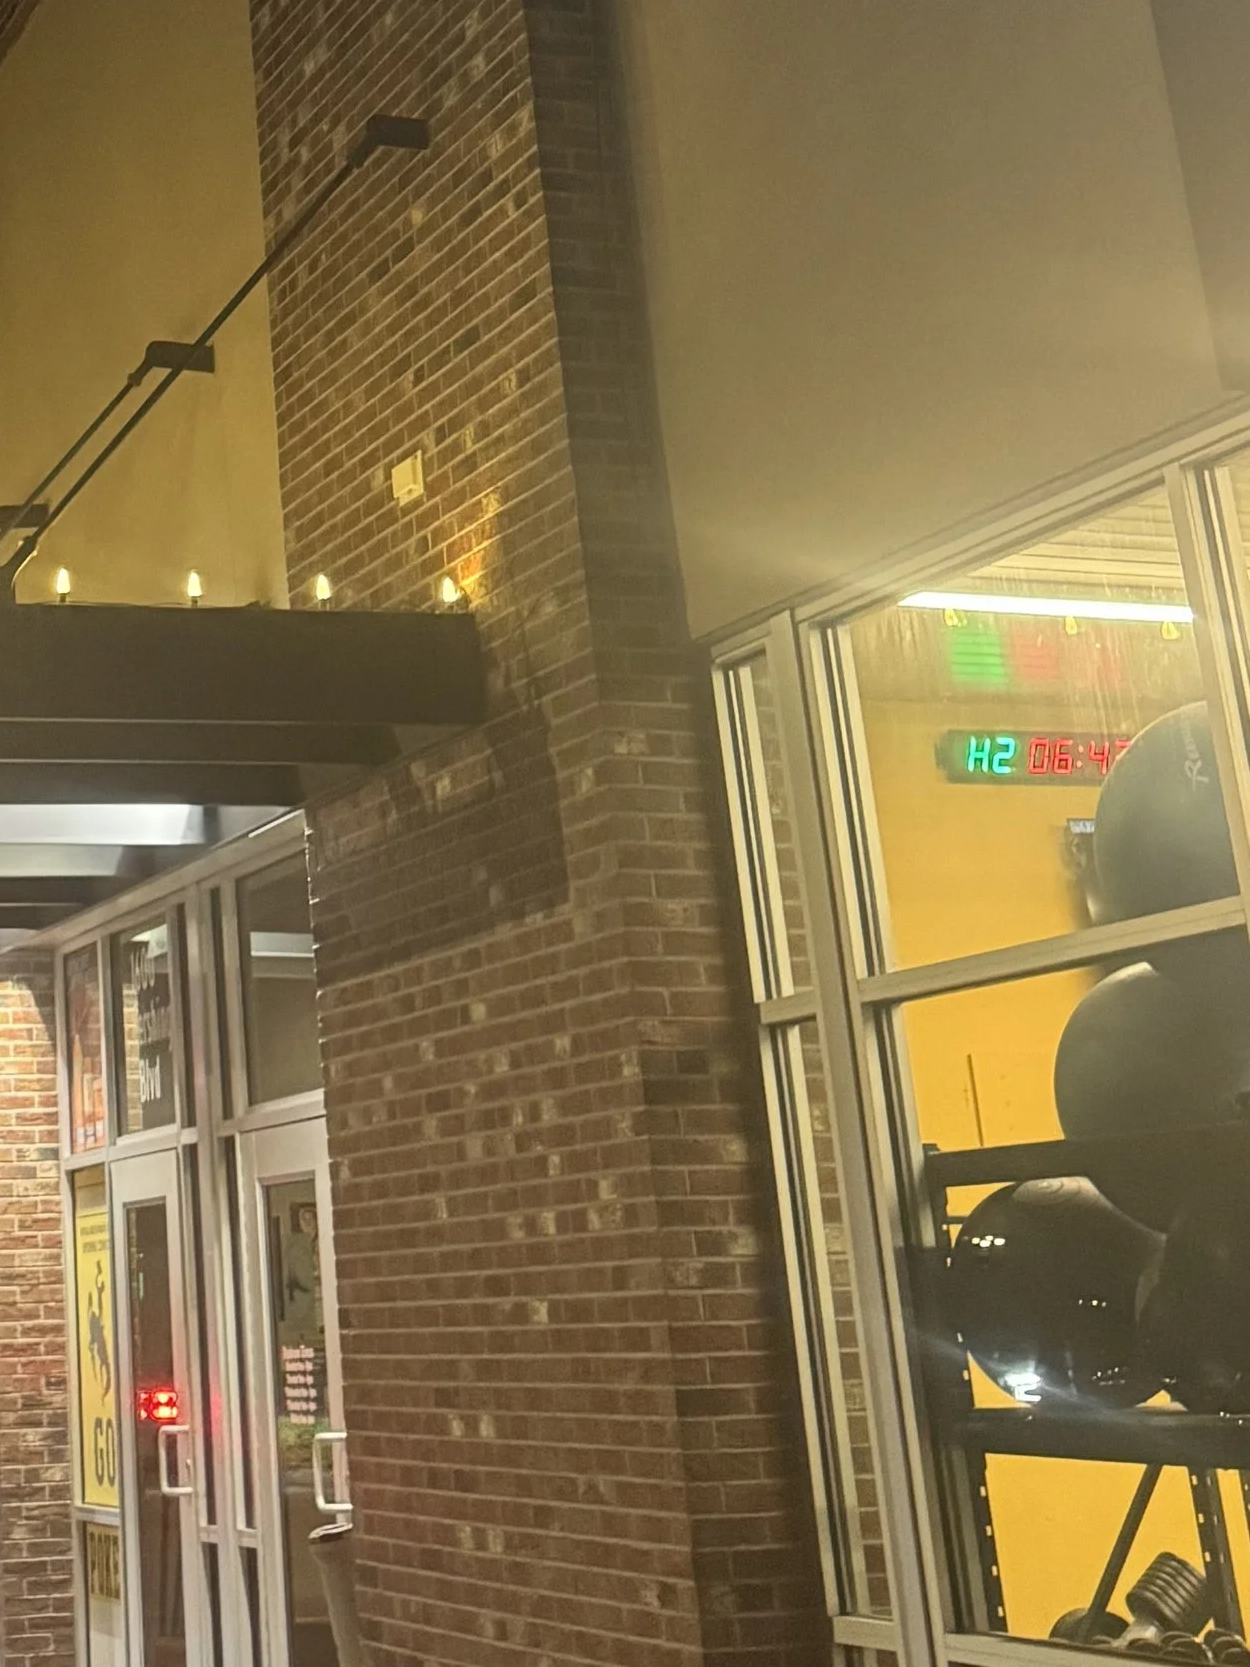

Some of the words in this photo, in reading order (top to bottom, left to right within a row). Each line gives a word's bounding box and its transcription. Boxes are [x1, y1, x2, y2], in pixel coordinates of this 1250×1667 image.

[967, 736, 1016, 774] H2
[1027, 737, 1132, 775] 06:4
[139, 1055, 161, 1103] Blvd
[93, 1417, 116, 1487] GO
